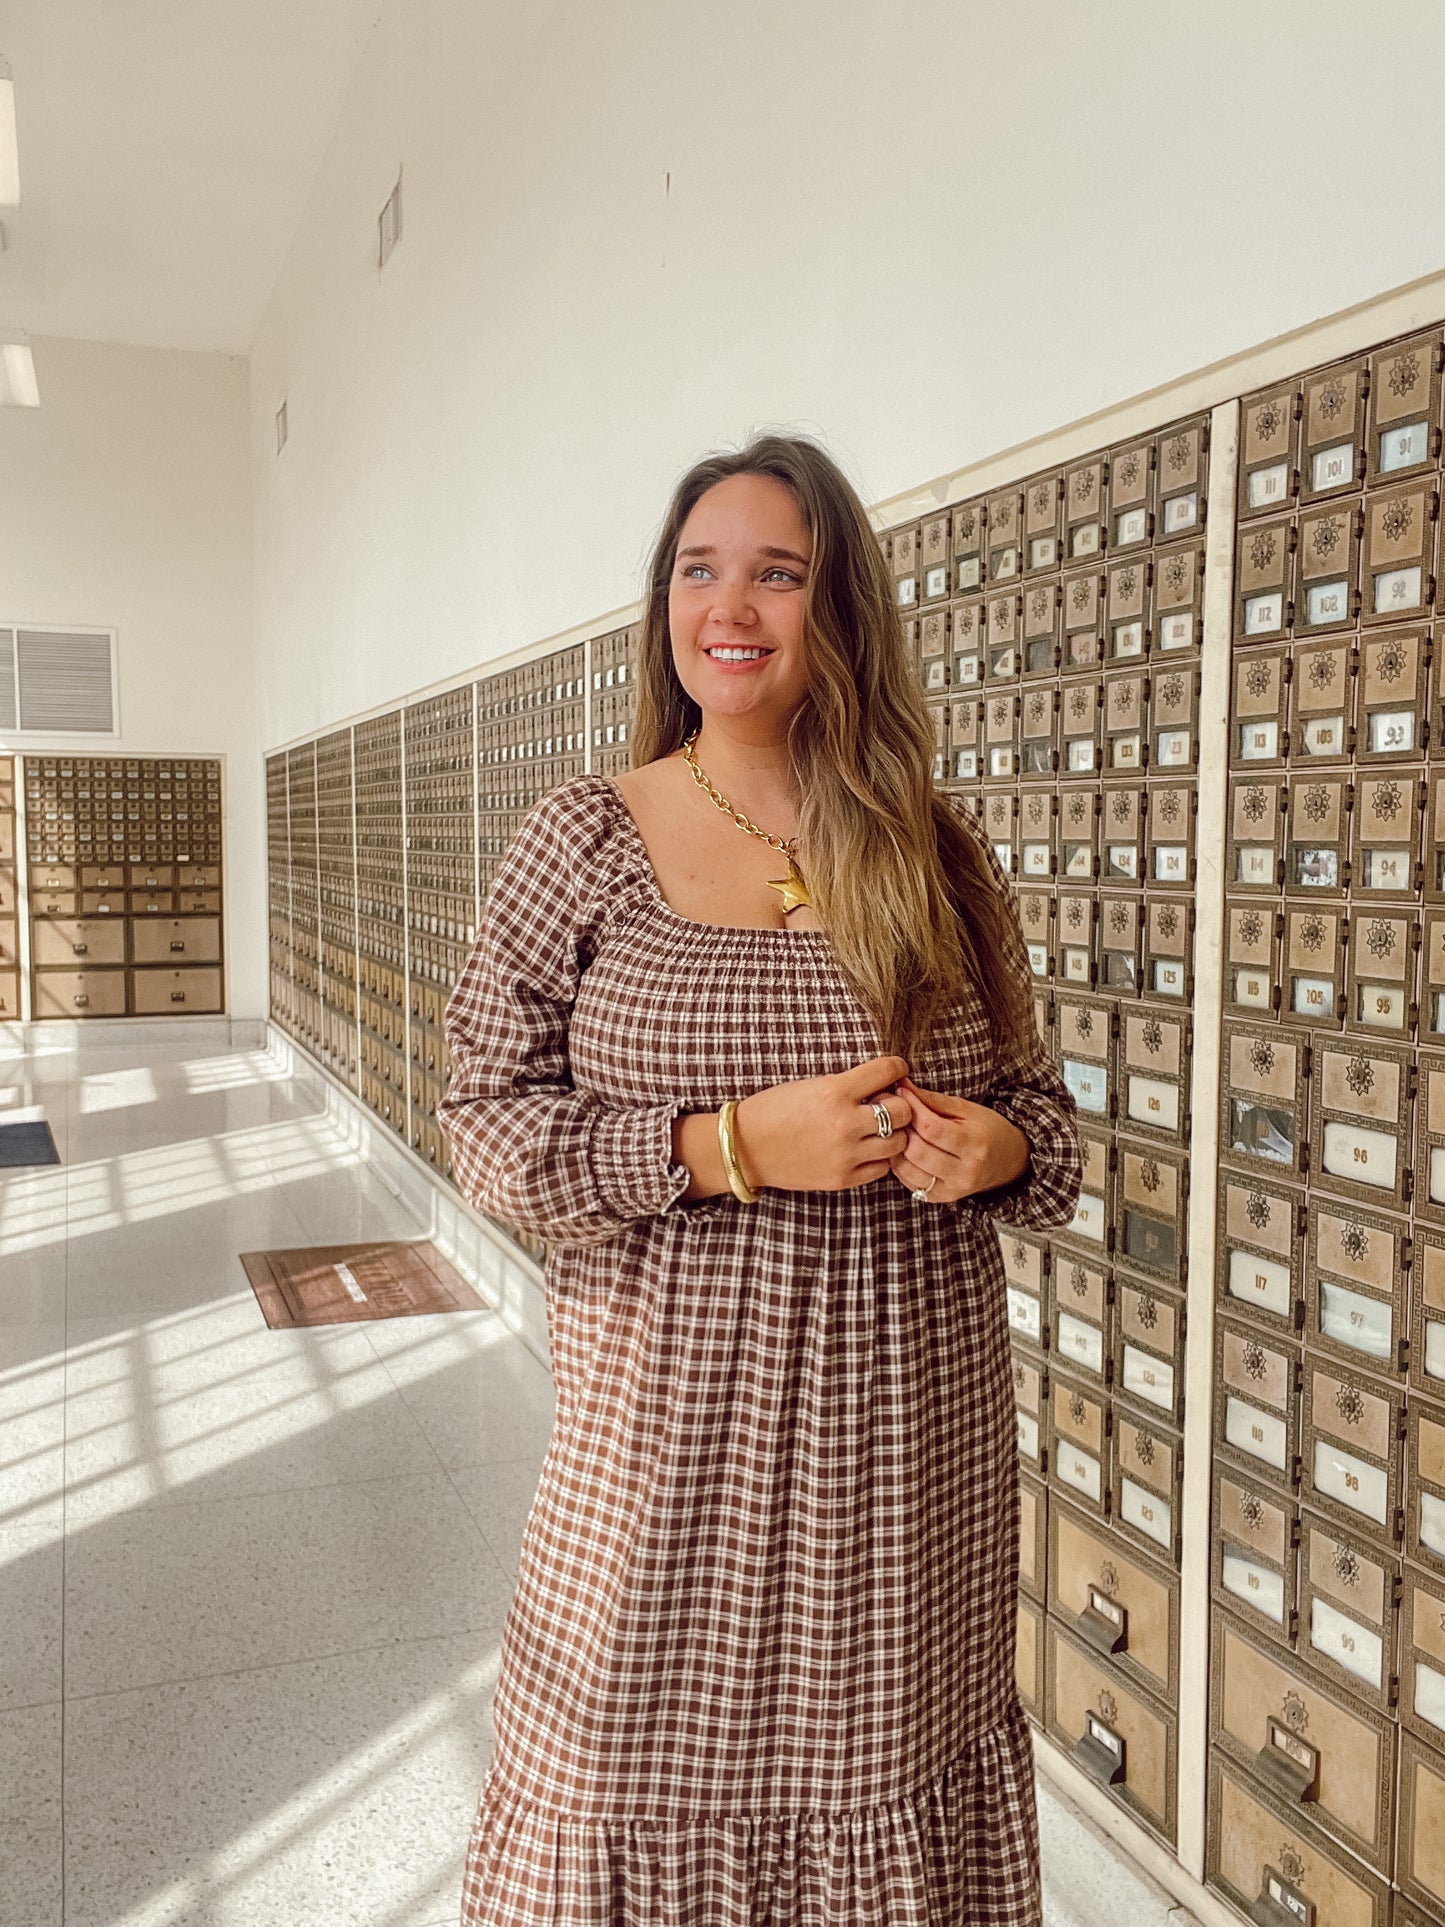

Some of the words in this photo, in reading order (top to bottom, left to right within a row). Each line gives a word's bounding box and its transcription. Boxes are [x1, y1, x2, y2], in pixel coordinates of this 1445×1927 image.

[1399, 437, 1411, 455] 91
[1327, 459, 1342, 477] 101
[1265, 477, 1276, 494] 111
[1392, 582, 1406, 598] 92
[1320, 595, 1337, 614] 102
[1258, 606, 1272, 622] 112
[1254, 733, 1266, 748] 113
[1316, 729, 1332, 744] 103
[1384, 726, 1405, 746] 93
[1166, 856, 1179, 870] 124
[1380, 860, 1396, 875] 94
[1163, 969, 1176, 983] 125
[1306, 989, 1323, 1005] 105
[1376, 998, 1390, 1014] 95
[1255, 1275, 1267, 1290] 117
[1350, 1311, 1364, 1326] 97
[1345, 1473, 1358, 1491] 98
[1342, 1634, 1354, 1651] 99
